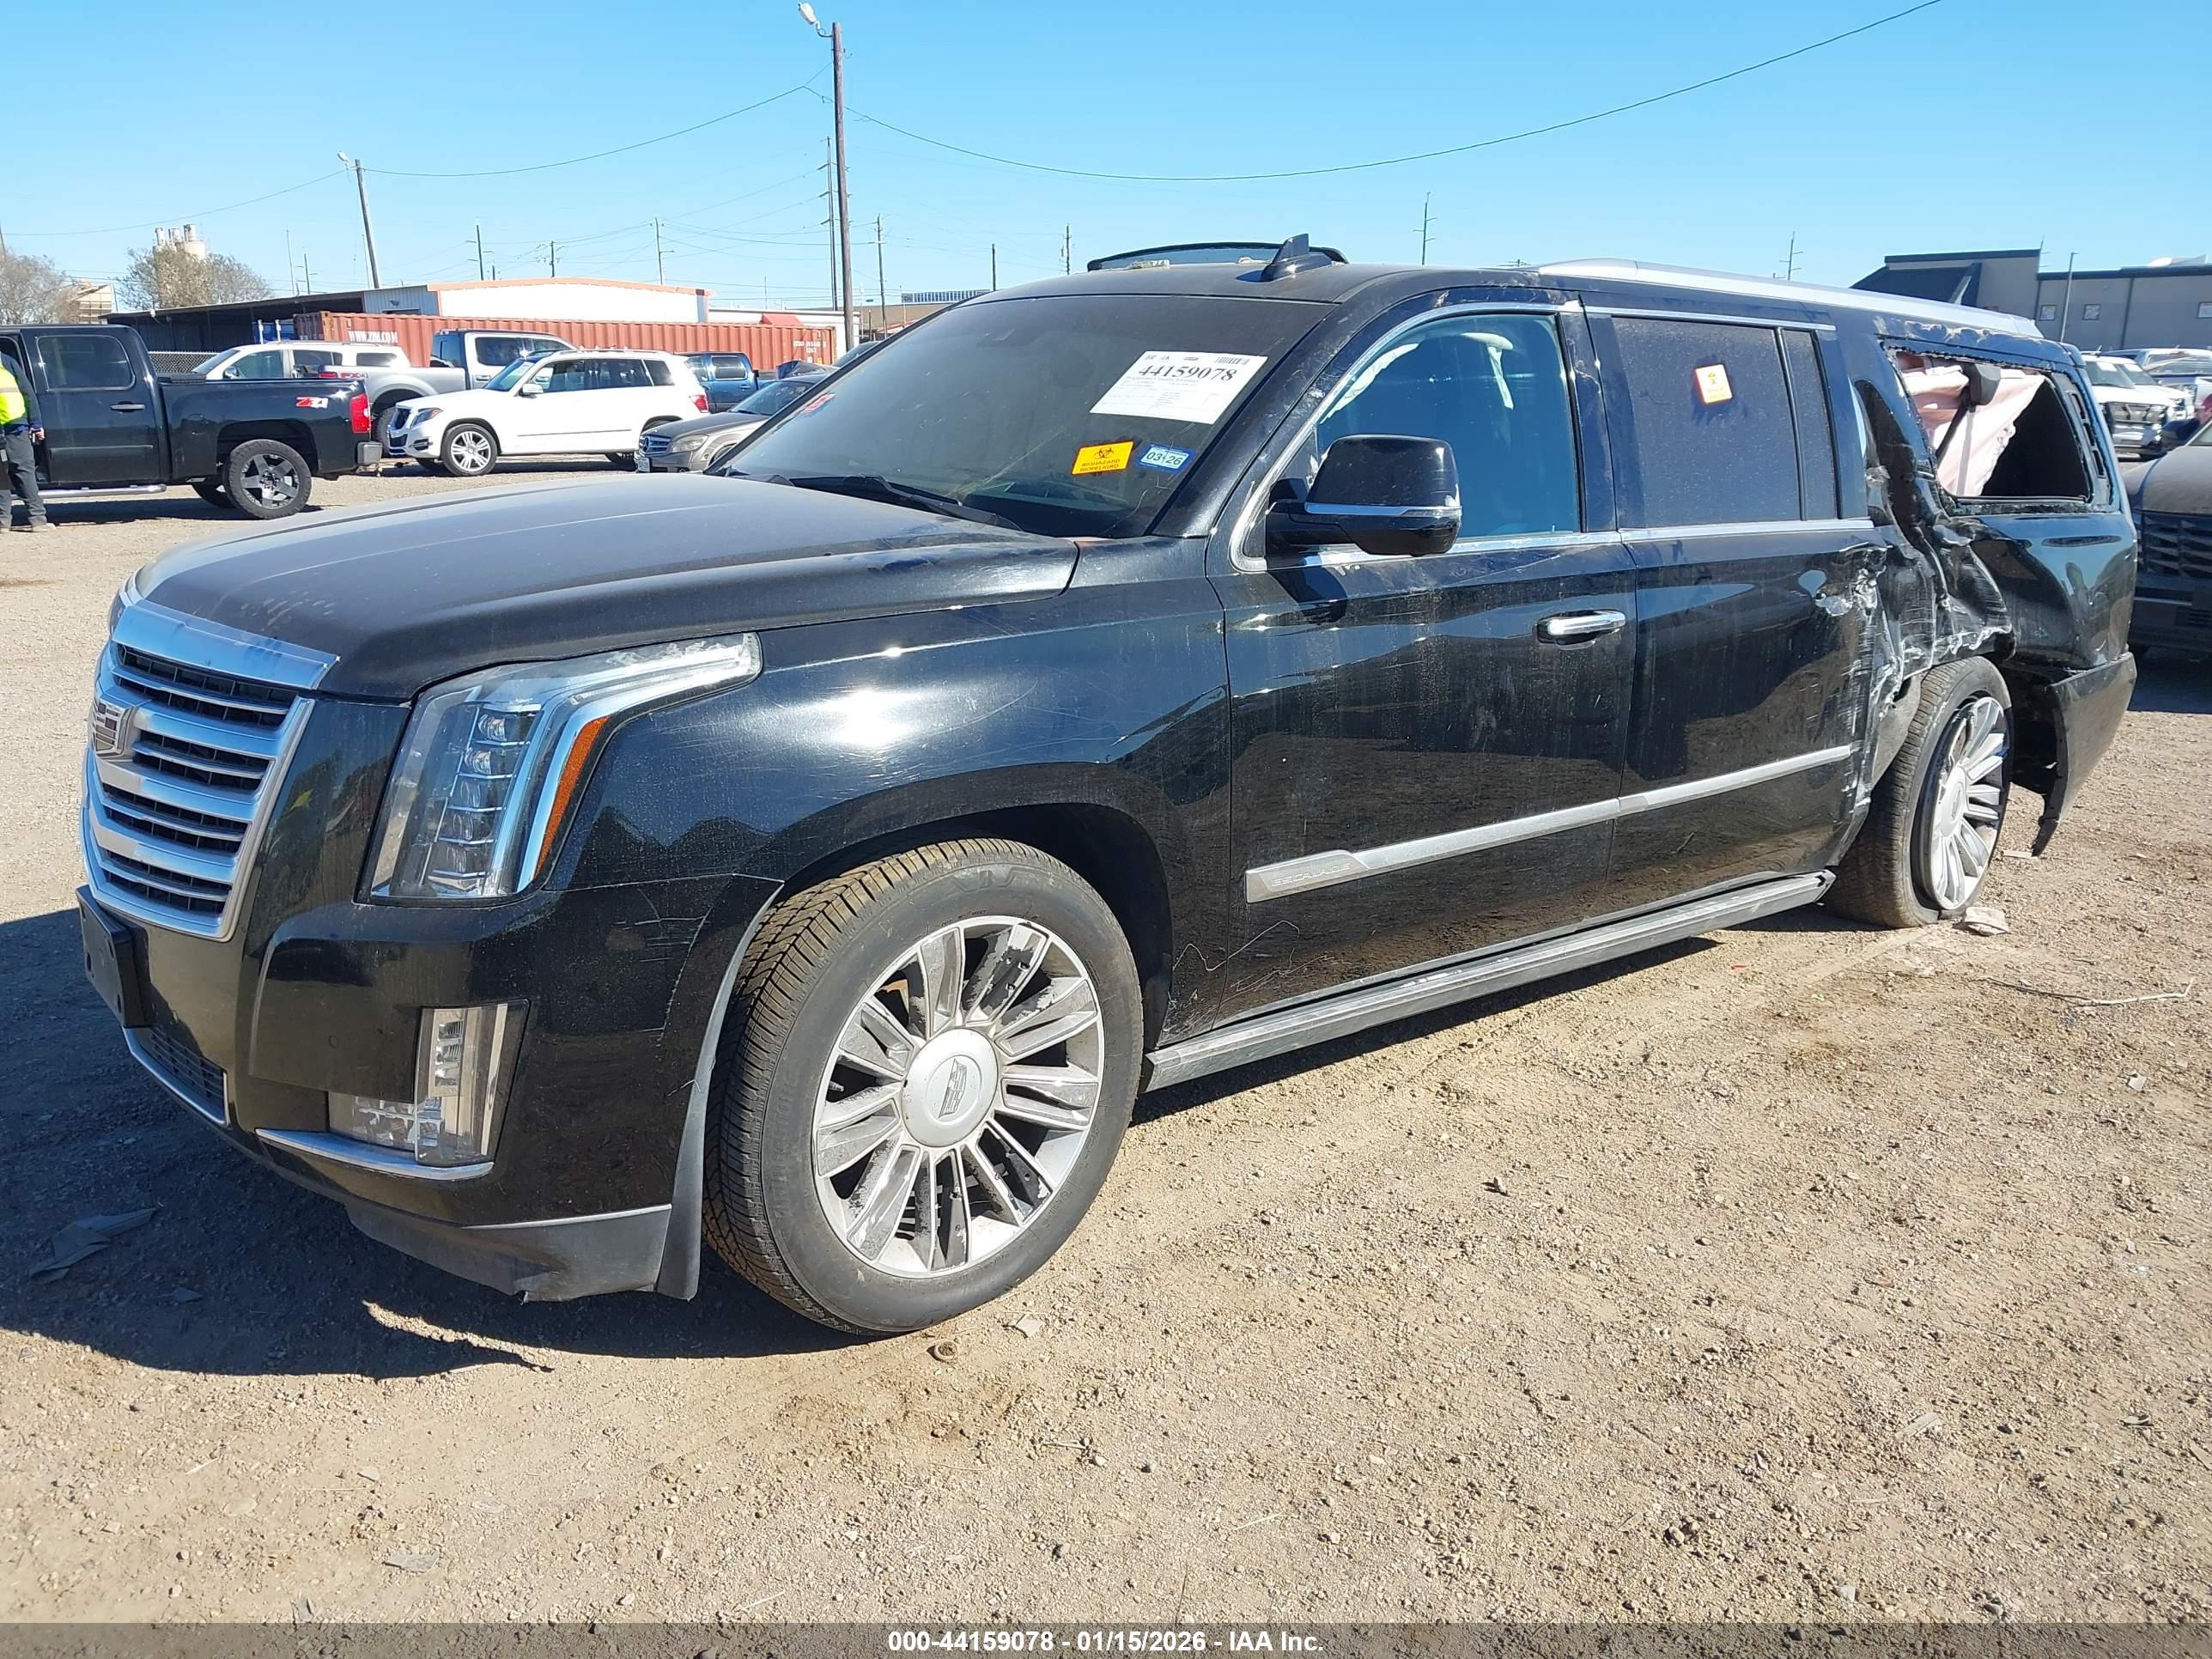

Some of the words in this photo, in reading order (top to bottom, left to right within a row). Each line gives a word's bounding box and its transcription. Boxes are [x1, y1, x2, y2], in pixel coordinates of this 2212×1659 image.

[1139, 364, 1237, 381] 44159078
[1146, 452, 1163, 461] 03
[1165, 455, 1183, 465] 26
